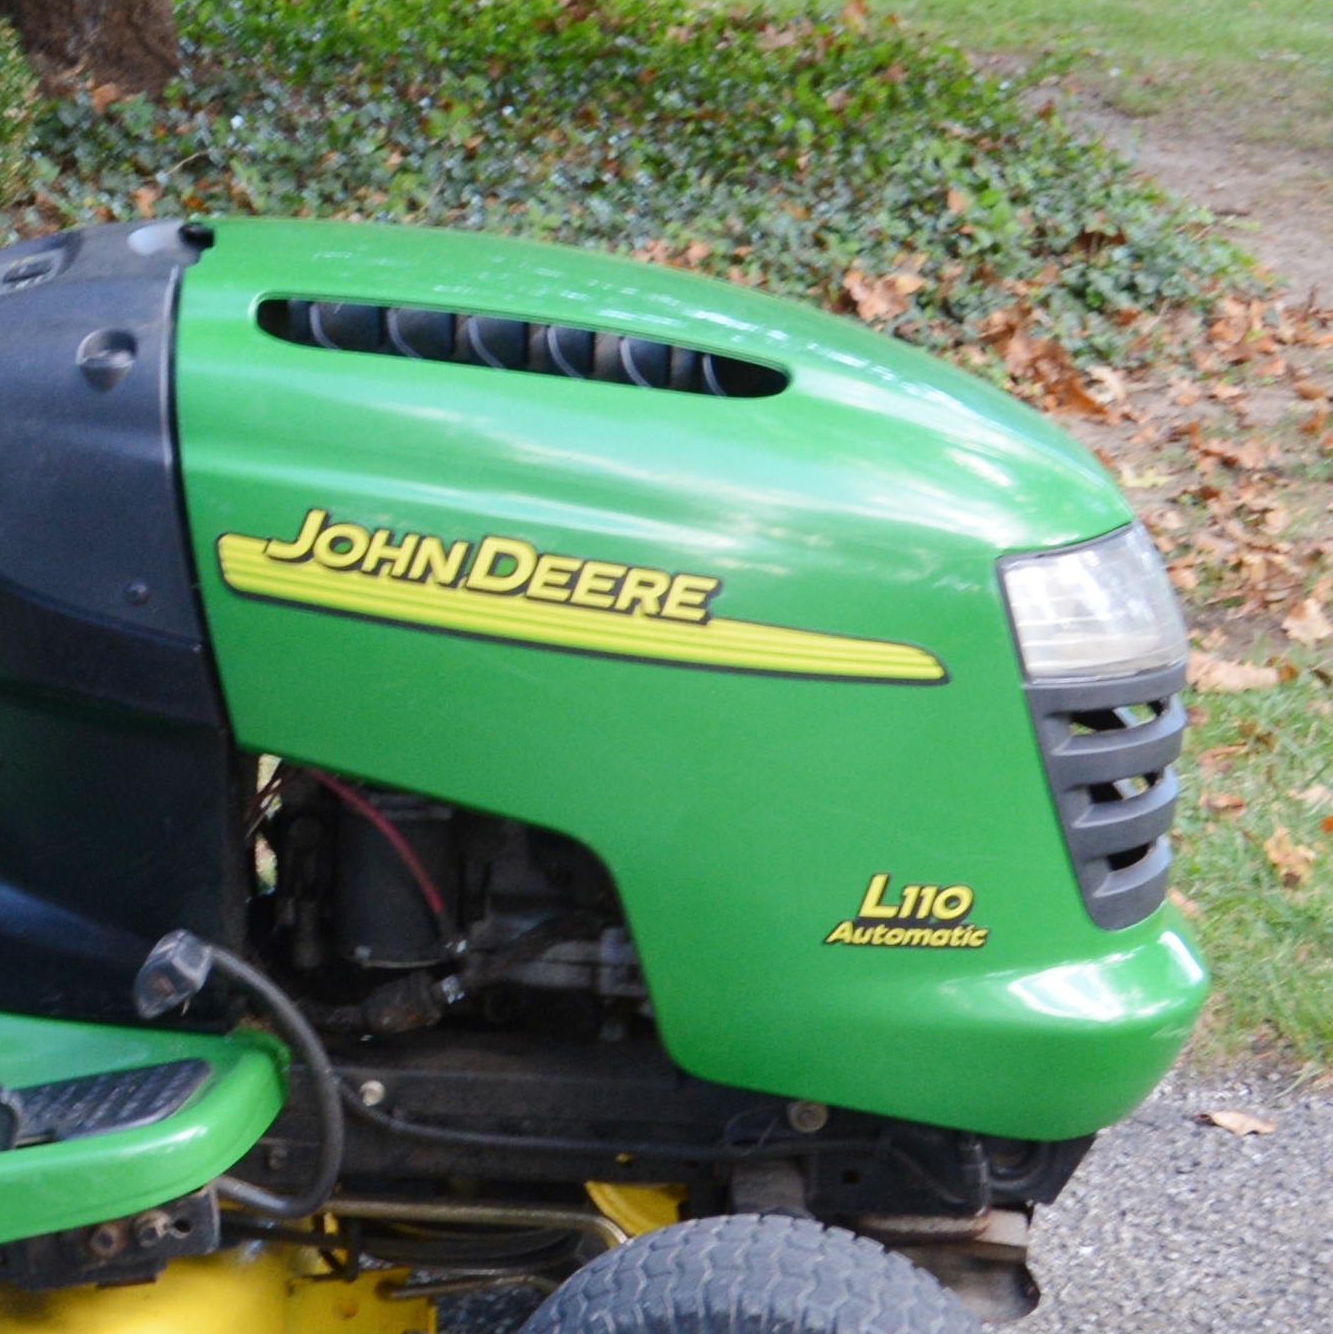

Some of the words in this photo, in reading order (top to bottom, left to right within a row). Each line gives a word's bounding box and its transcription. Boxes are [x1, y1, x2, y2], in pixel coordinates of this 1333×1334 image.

[265, 508, 467, 587] JOHN
[465, 536, 720, 623] DEERE
[858, 872, 974, 920] L110
[824, 920, 989, 948] Automatic
